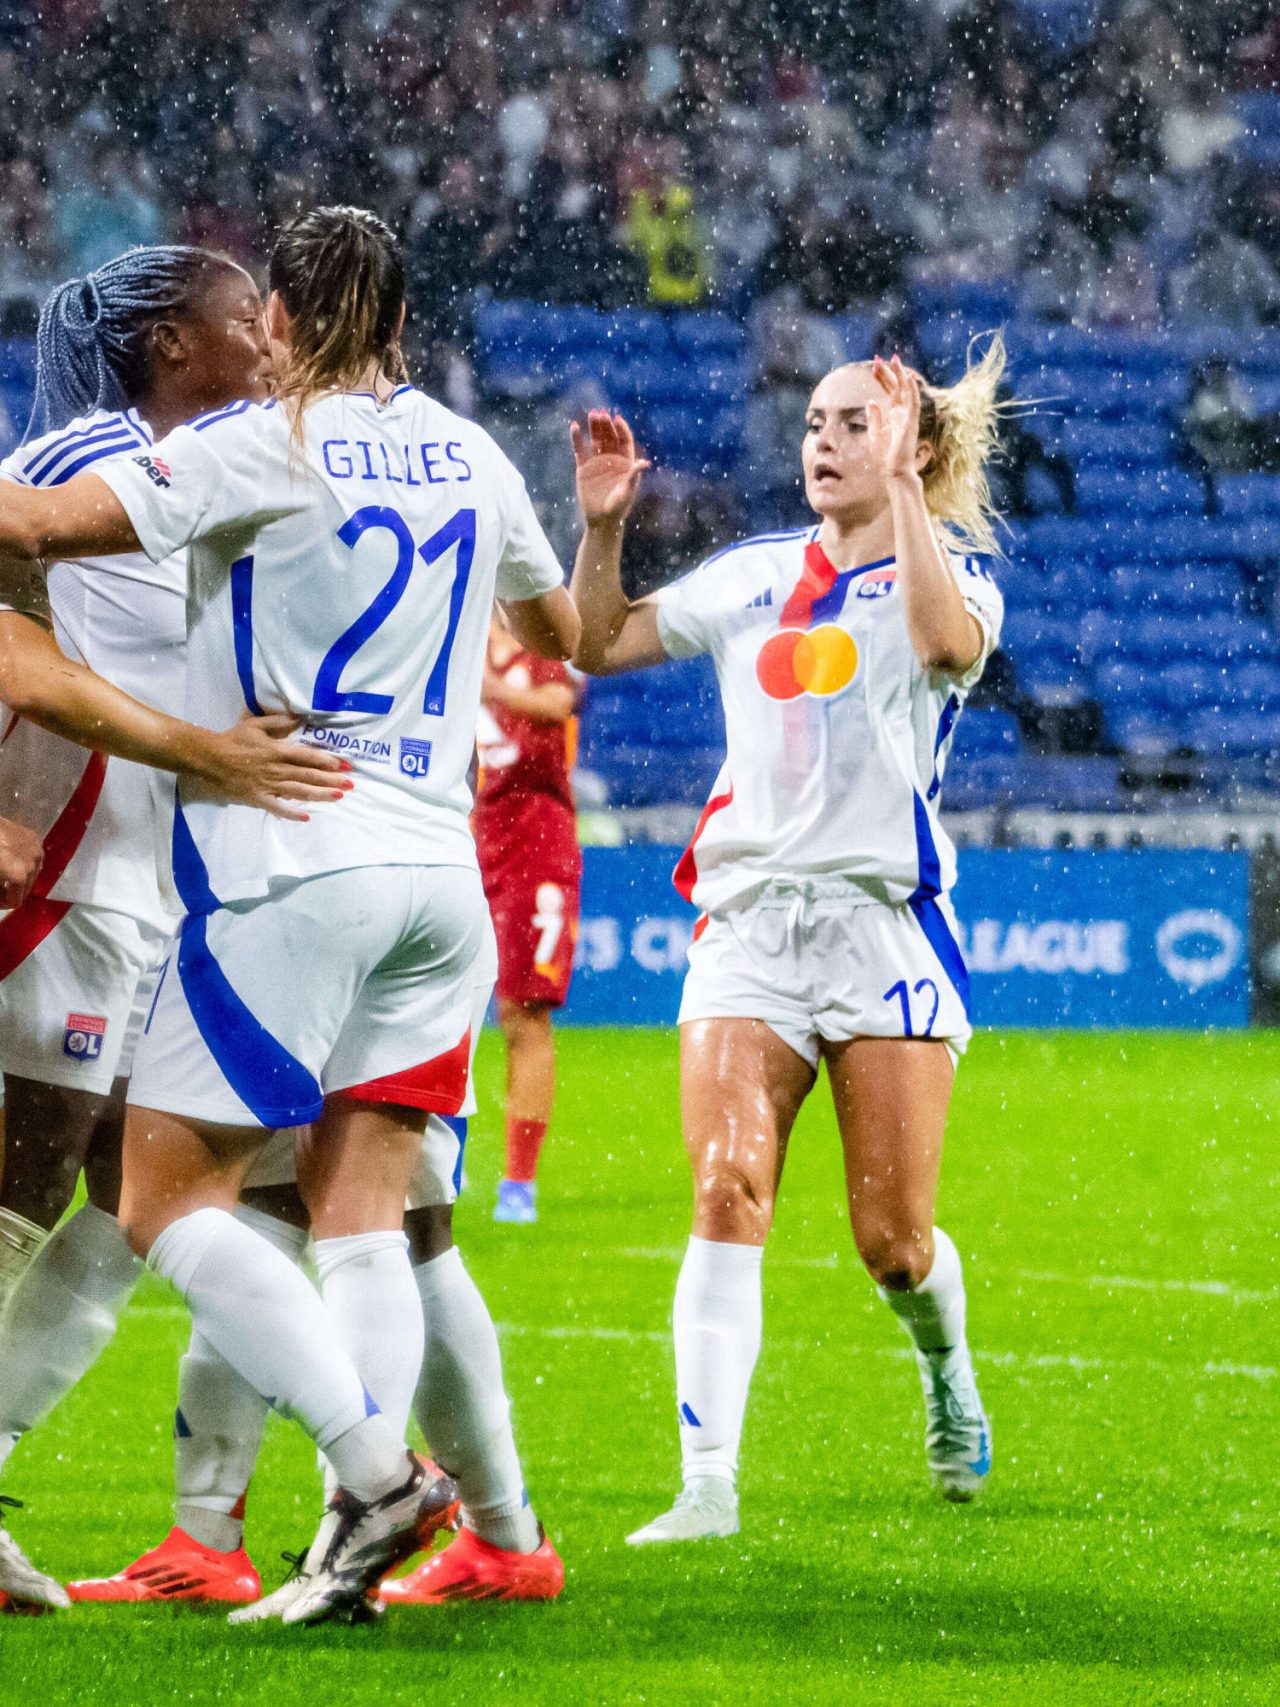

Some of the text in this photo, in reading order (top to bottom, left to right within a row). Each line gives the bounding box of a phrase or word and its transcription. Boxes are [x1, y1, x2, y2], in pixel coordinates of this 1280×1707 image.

[322, 439, 472, 486] GILLES
[311, 505, 477, 717] 21
[402, 754, 426, 775] OL
[883, 978, 938, 1038] 12
